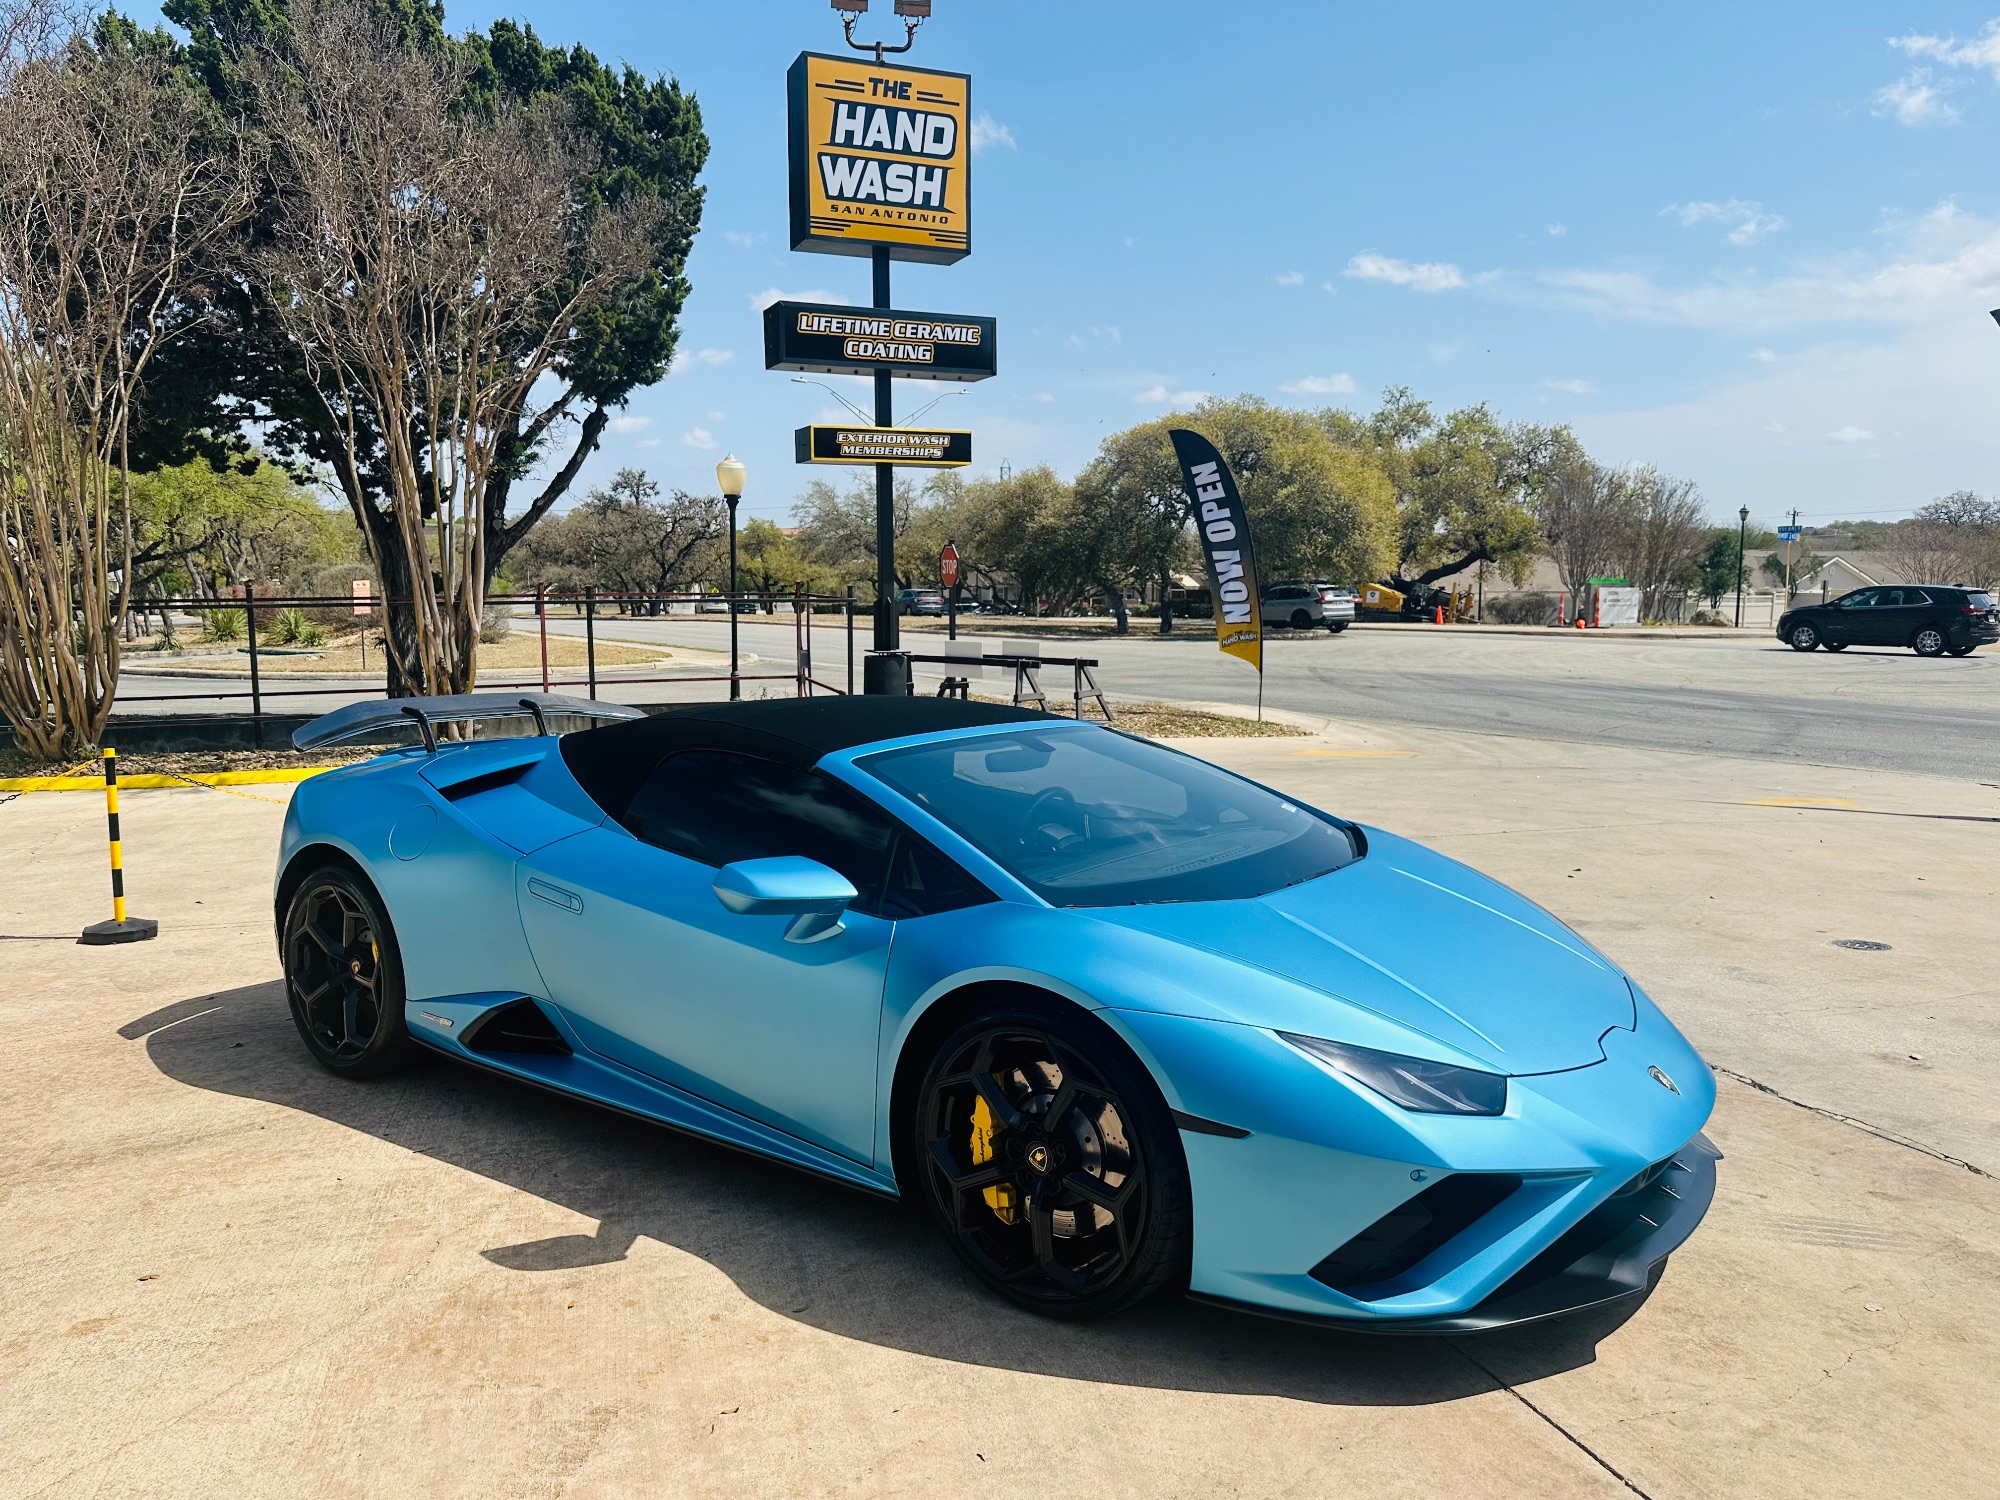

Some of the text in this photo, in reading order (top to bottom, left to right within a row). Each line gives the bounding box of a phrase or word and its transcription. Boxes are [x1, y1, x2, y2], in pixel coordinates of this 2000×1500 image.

[868, 77, 912, 100] THE
[834, 103, 955, 156] HAND
[821, 155, 943, 207] WASH
[830, 204, 949, 224] SAN ANTONIO
[799, 315, 980, 343] LIFETIME CERAMIC
[845, 340, 932, 360] COATING
[838, 433, 950, 445] EXTERIOR WASH
[842, 445, 942, 457] MEMBERSHIPS
[1190, 460, 1252, 624] NOW OPEN
[942, 560, 957, 574] STOP
[1222, 636, 1239, 646] HAND
